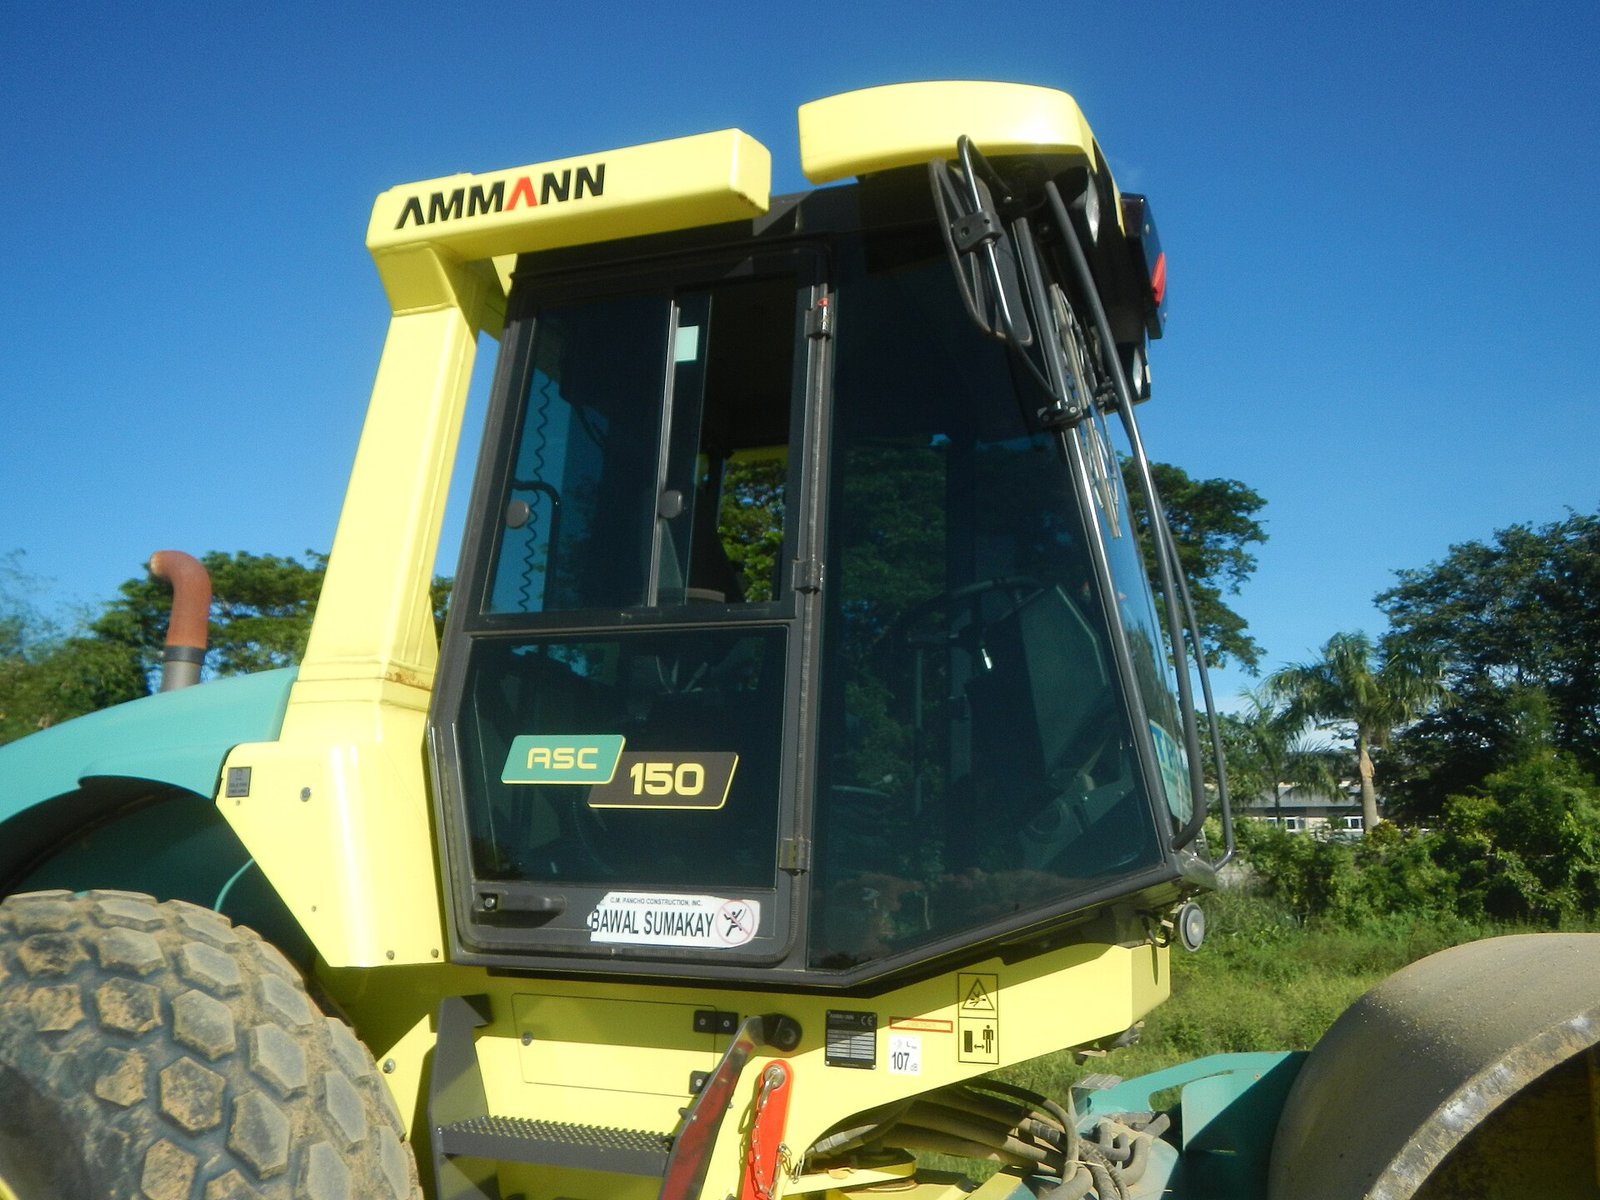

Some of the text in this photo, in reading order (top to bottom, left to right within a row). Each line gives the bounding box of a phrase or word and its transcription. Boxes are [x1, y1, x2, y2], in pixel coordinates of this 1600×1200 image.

[394, 163, 605, 230] AMMANN
[526, 747, 599, 770] ASC
[629, 762, 705, 796] 150
[591, 909, 715, 938] BAWAL SUMAKAY
[891, 1051, 910, 1071] 107
